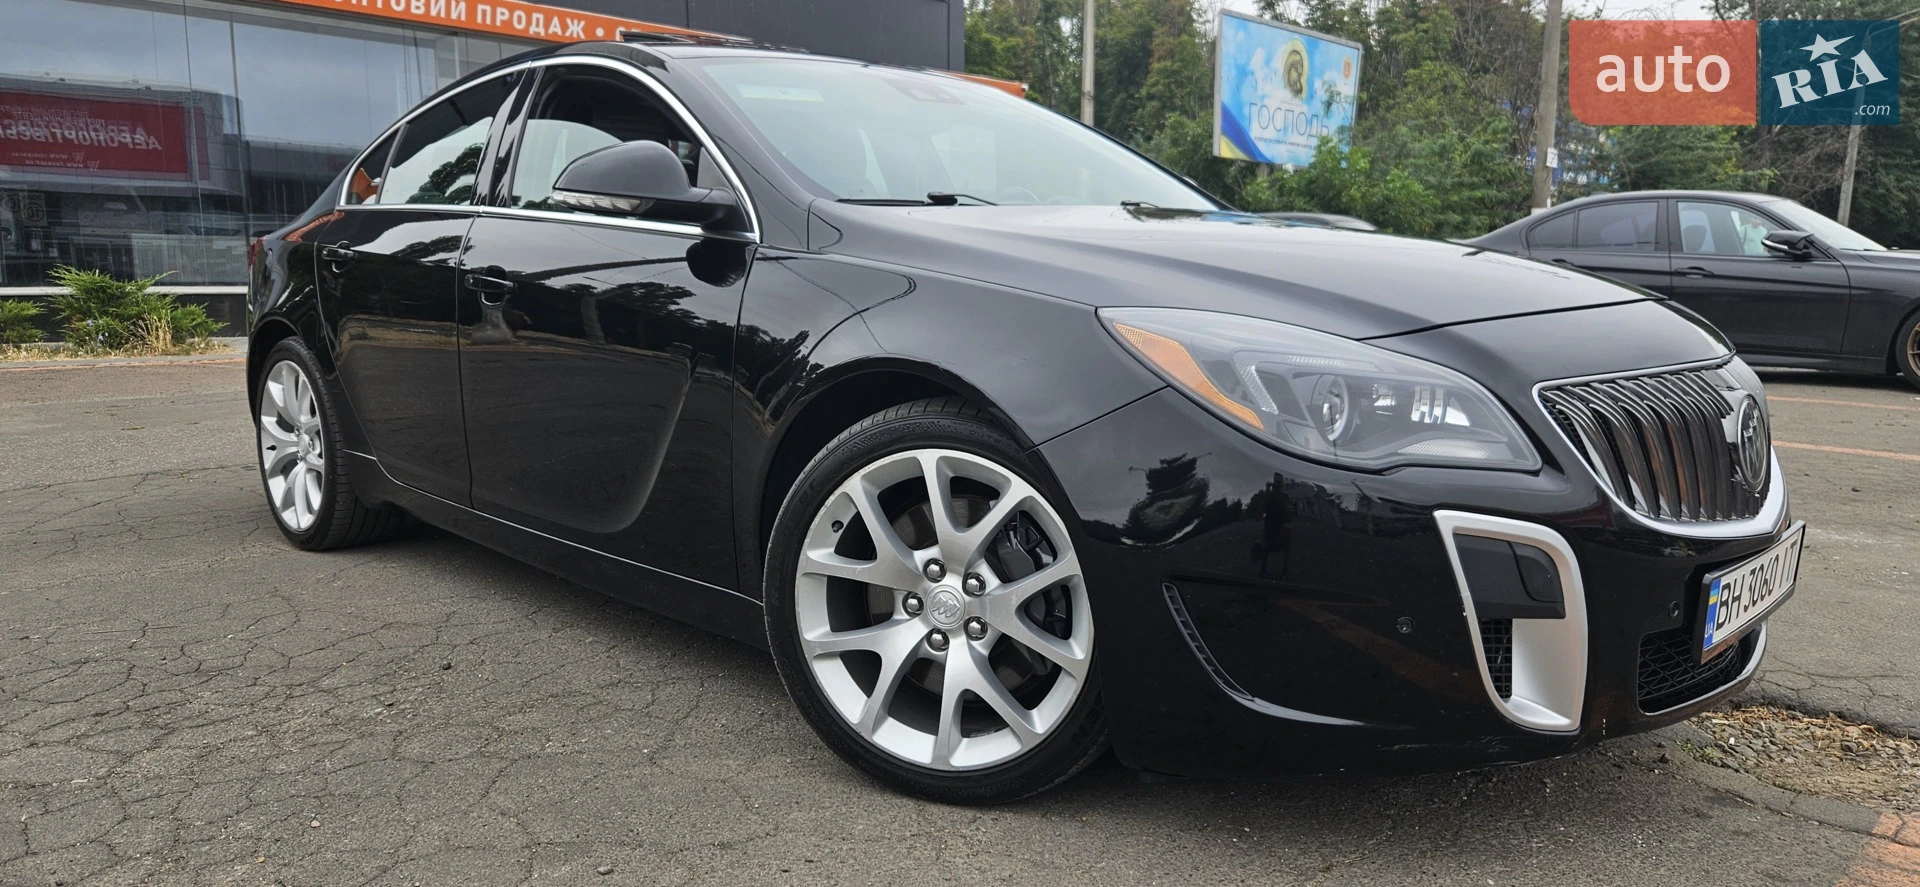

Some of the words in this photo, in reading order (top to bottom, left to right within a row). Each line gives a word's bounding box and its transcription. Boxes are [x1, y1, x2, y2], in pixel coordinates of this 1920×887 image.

[477, 3, 585, 39] ПРОДАЖ
[1249, 102, 1330, 142] ГОСПОДЬ
[1715, 573, 1746, 632] BH
[1743, 553, 1780, 613] 3060
[1705, 622, 1714, 638] UA
